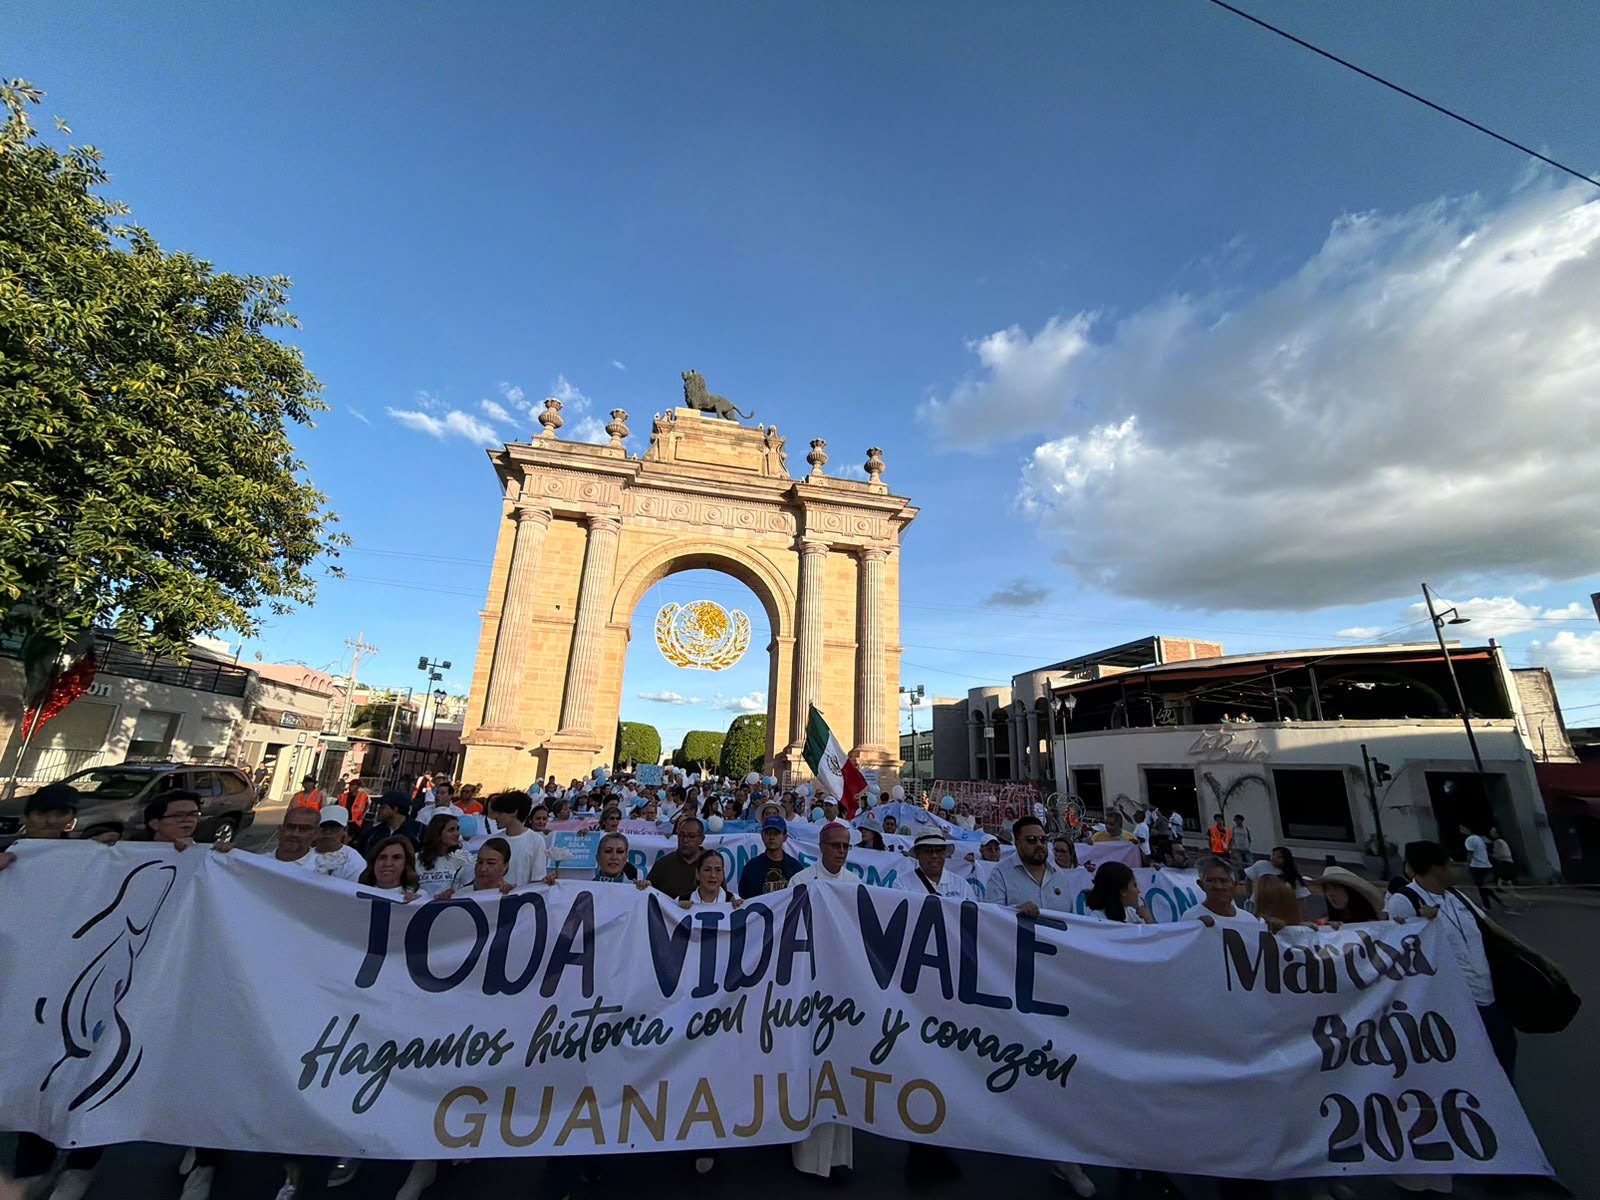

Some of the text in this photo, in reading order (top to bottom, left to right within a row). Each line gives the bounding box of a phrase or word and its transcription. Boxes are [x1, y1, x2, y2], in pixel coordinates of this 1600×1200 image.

[355, 889, 596, 999] TODA
[647, 883, 816, 999] VIDA
[856, 883, 1070, 1018] VALE
[1222, 927, 1438, 994] Marcha
[297, 1013, 515, 1115] Hagamos
[524, 995, 674, 1068] historia
[685, 993, 747, 1041] con
[869, 1007, 910, 1066] y
[920, 1014, 1078, 1094] corazón
[433, 1059, 947, 1149] GUANAJUATO
[1319, 1088, 1498, 1163] 2026
